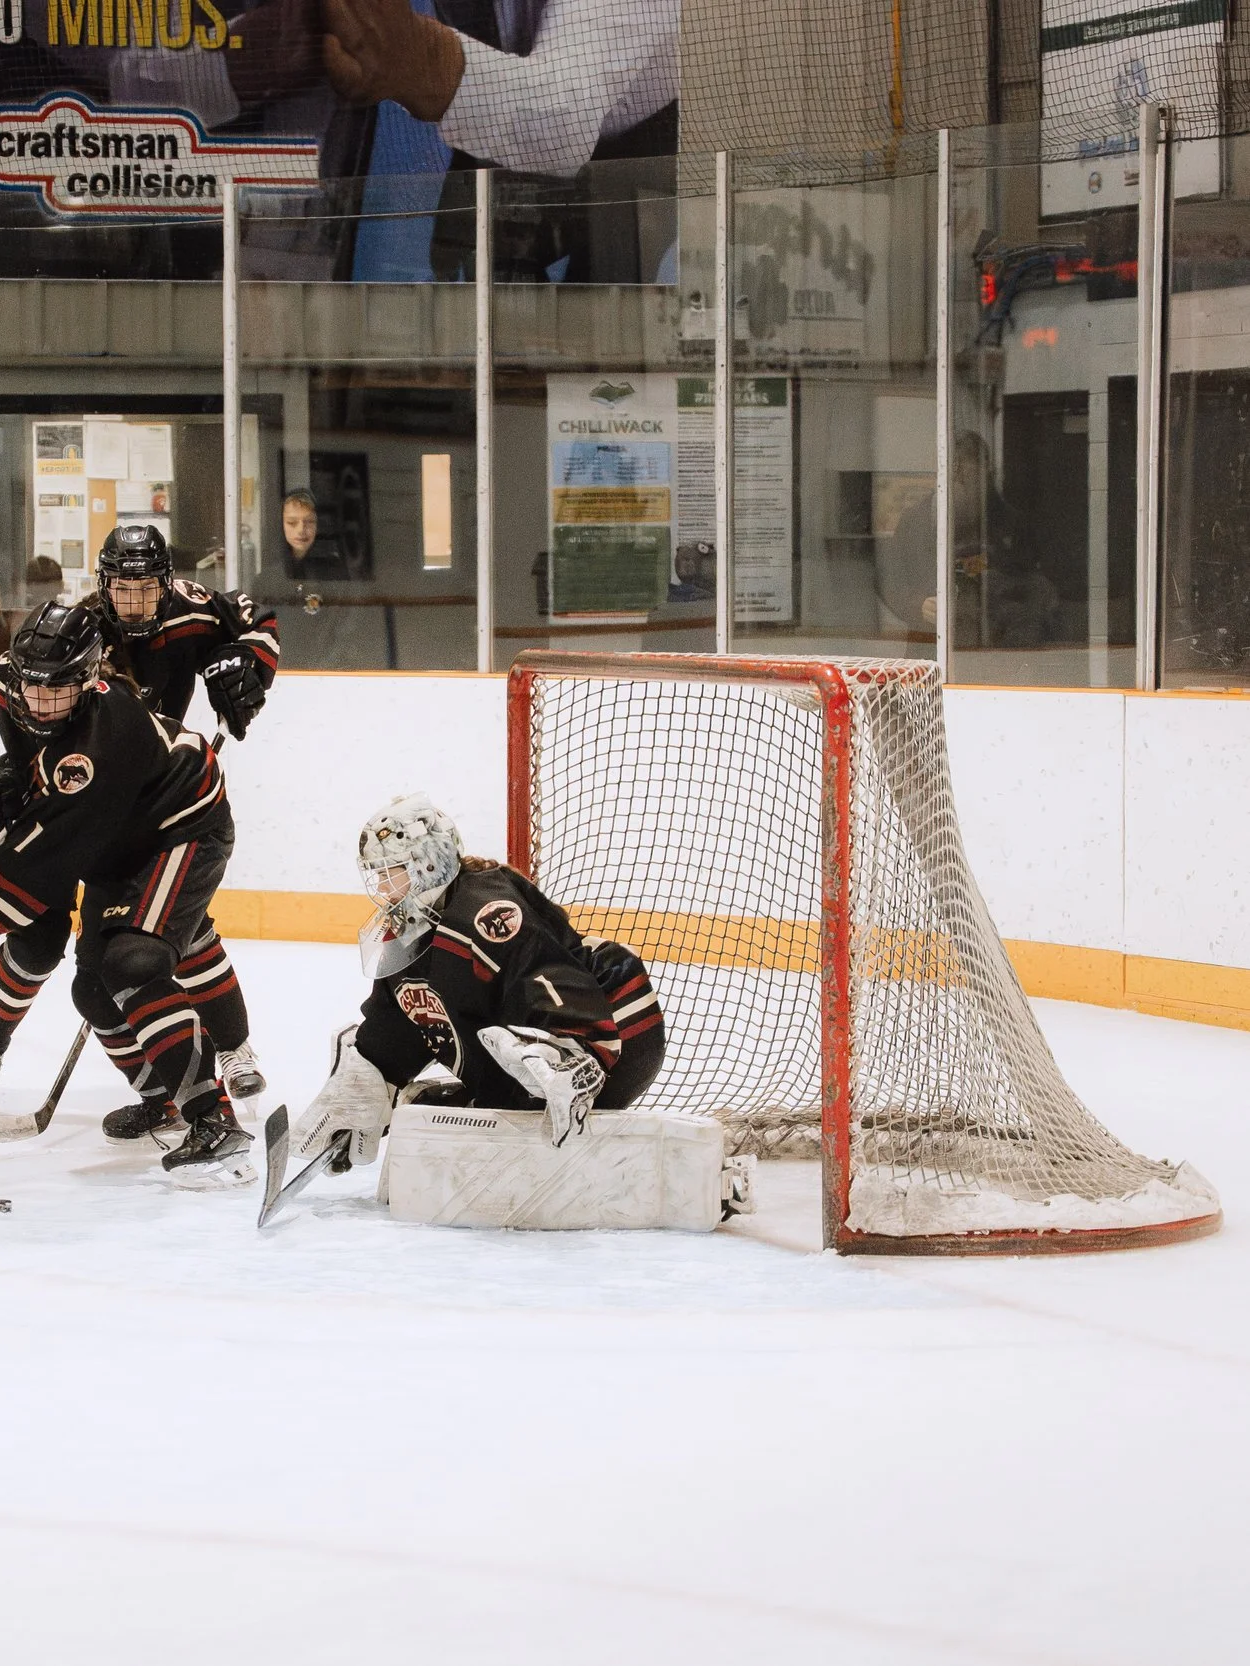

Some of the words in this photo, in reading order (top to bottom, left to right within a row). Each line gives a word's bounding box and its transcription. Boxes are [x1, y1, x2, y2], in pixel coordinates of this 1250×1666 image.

[66, 164, 217, 199] collision
[557, 419, 664, 434] CHILLIWACK
[22, 668, 50, 679] CCM
[203, 656, 242, 679] CM
[102, 905, 131, 918] CM
[431, 1114, 498, 1129] WARRIOR
